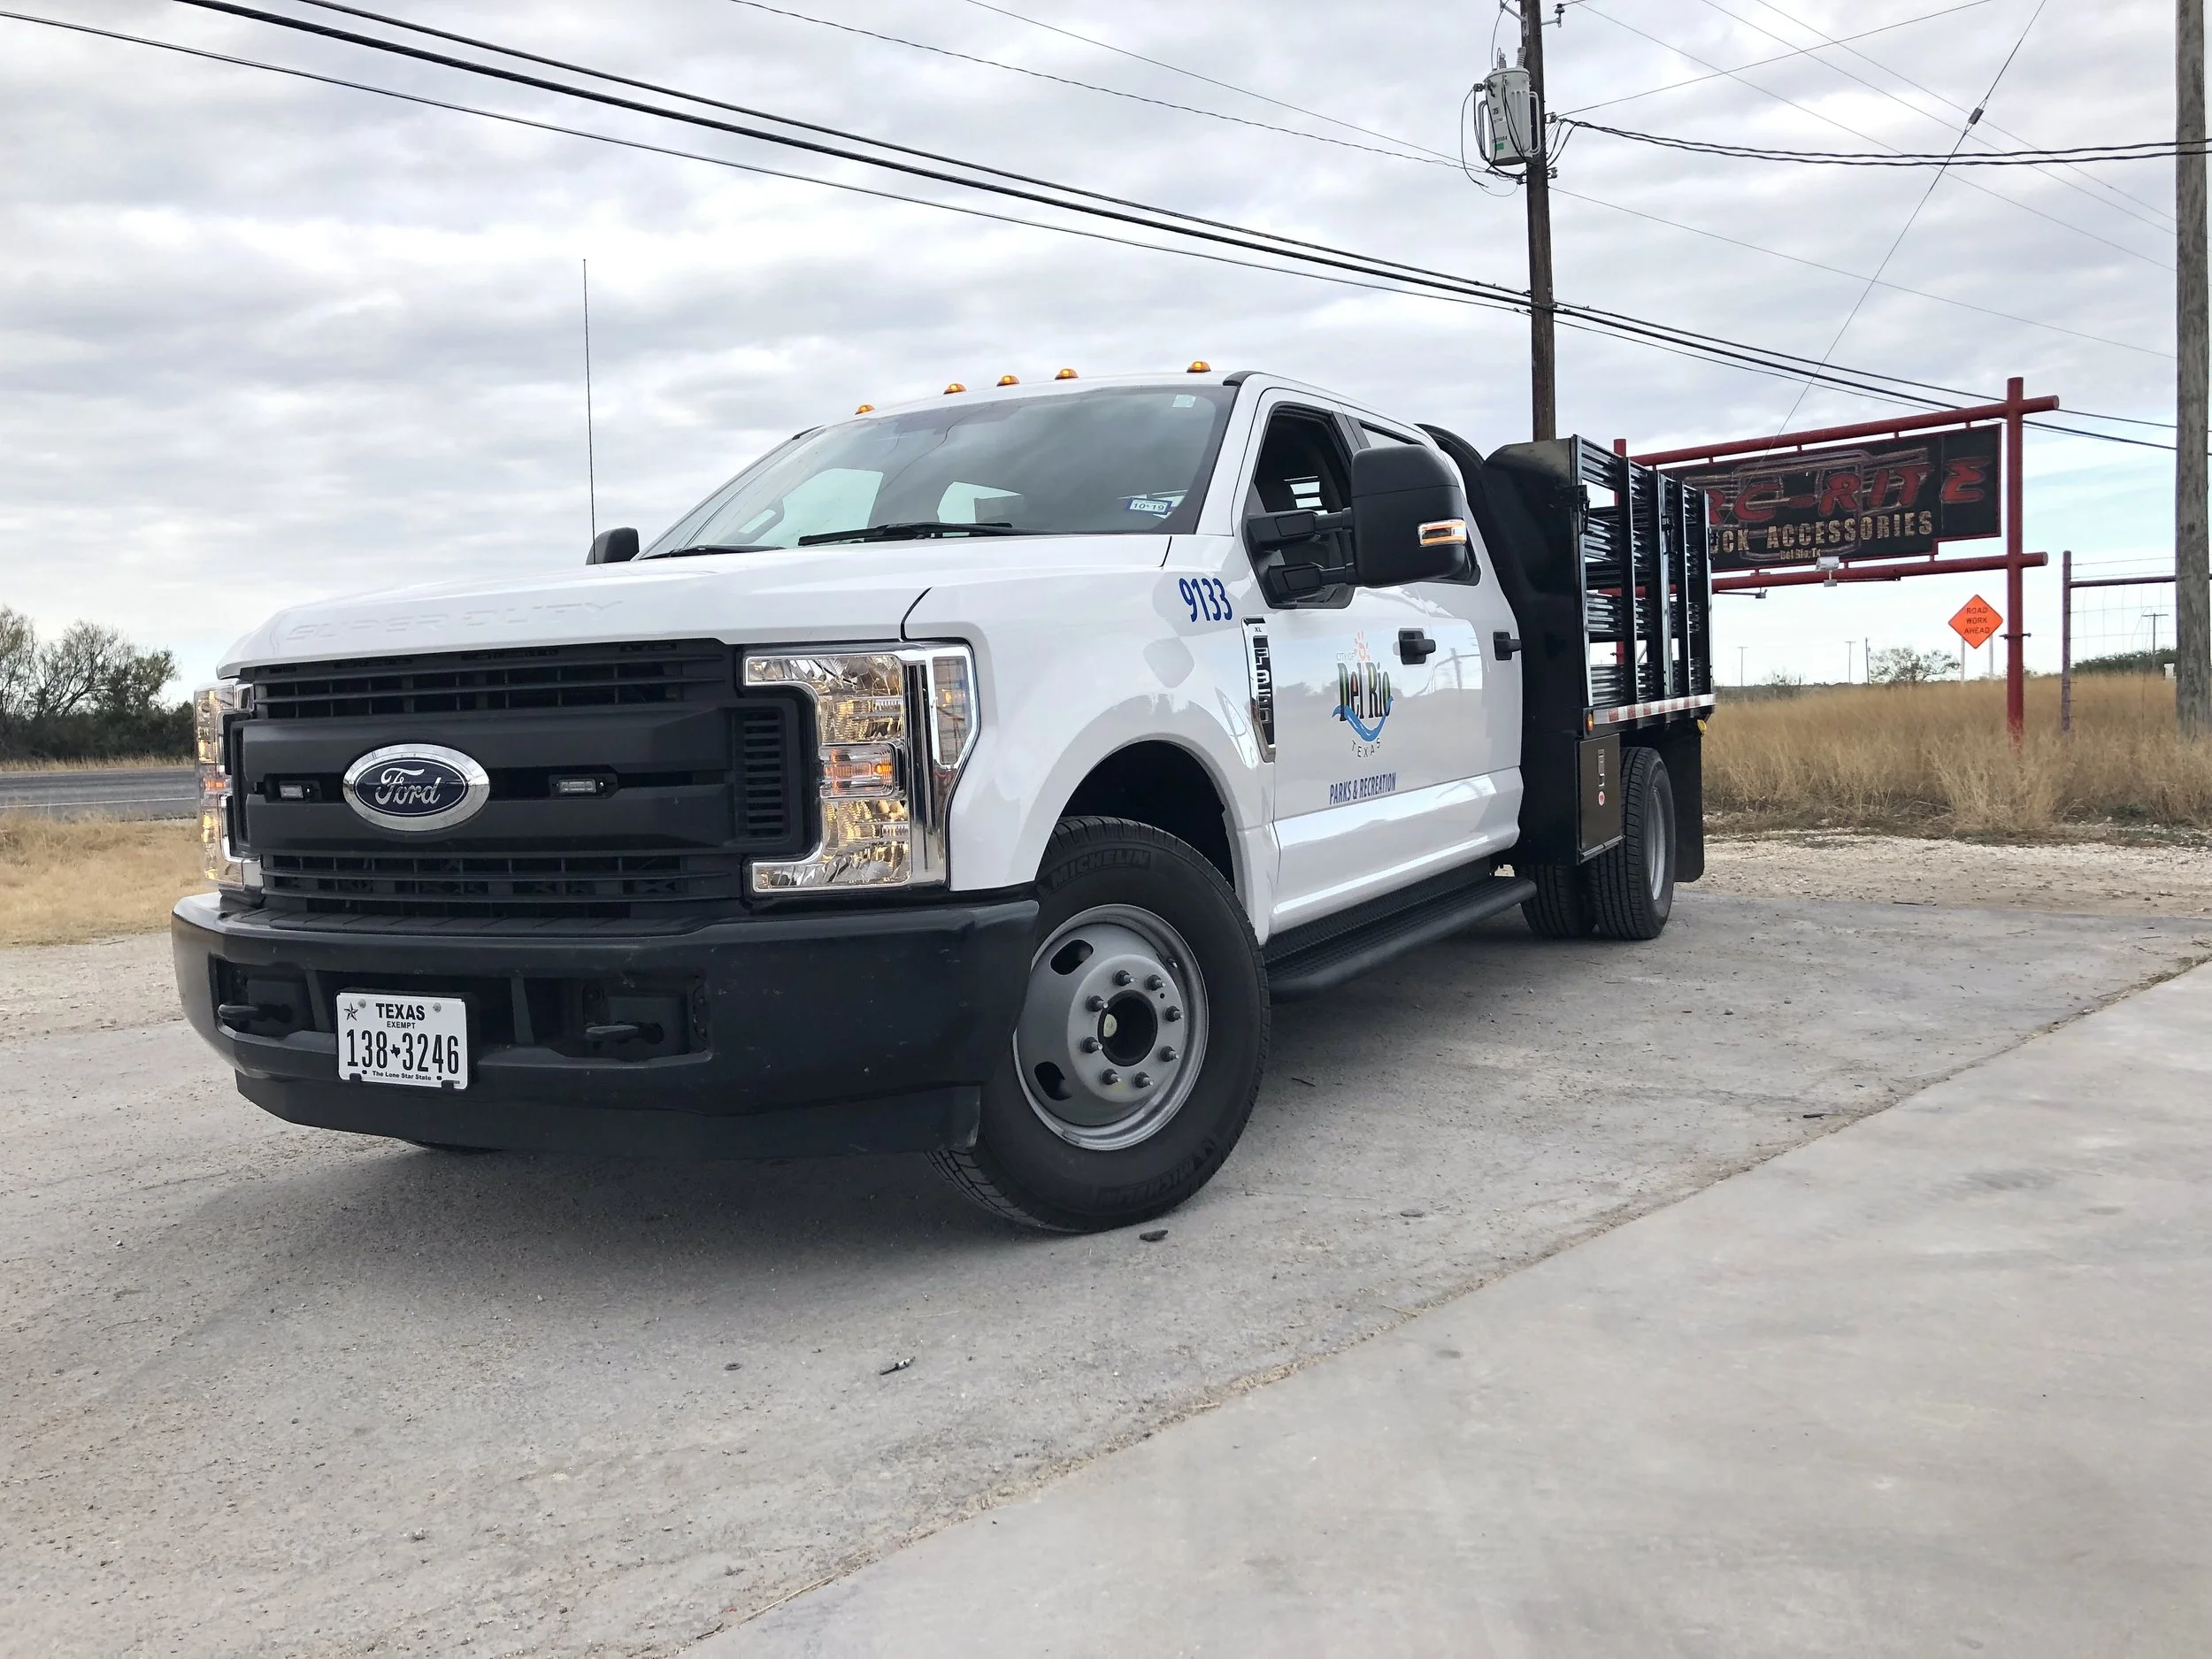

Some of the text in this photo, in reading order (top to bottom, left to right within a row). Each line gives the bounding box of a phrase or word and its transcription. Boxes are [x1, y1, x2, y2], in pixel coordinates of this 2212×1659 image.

[1707, 455, 1991, 525] RC-RITE
[1709, 511, 1933, 554] UCK ACCESSORIES
[1179, 578, 1233, 623] 9133
[1352, 738, 1381, 758] TEXAS
[374, 767, 442, 805] Ford
[1329, 772, 1397, 805] PARKS & RECREATION
[1050, 848, 1151, 890] MICHELIN
[375, 1002, 426, 1021] TEXAS
[387, 1021, 416, 1030] EXEMPT
